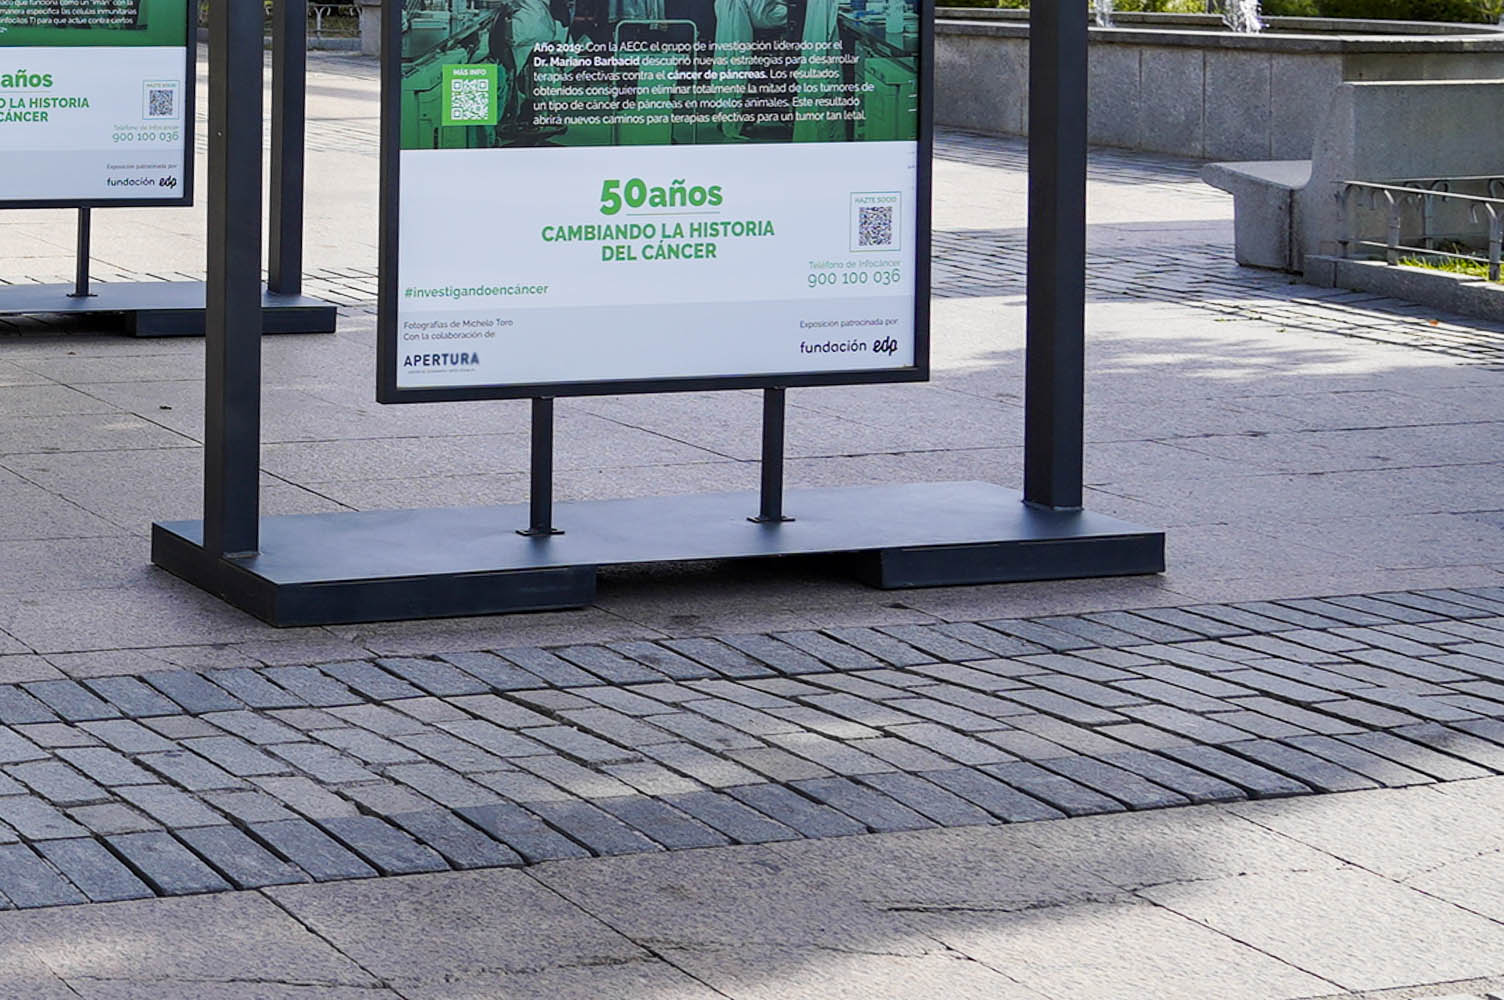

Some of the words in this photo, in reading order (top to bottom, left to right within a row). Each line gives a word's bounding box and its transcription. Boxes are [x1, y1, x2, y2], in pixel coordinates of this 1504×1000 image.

[534, 42, 555, 52] Año
[586, 42, 607, 52] Con
[608, 42, 618, 51] la
[619, 41, 648, 51] AECC
[650, 41, 660, 51] el
[661, 42, 692, 53] grupo
[693, 41, 707, 51] de
[708, 40, 772, 53] investigación
[773, 40, 813, 51] liderado
[815, 42, 832, 52] por
[833, 40, 843, 50] el
[533, 57, 548, 67] Dr.
[549, 57, 593, 66] Mariano
[594, 56, 640, 66] Barbacid
[641, 55, 692, 66] descubrió
[693, 57, 728, 65] nuevas
[730, 55, 783, 67] estrategias
[785, 57, 807, 67] para
[808, 54, 859, 64] desarrollar
[533, 72, 574, 83] terapias
[576, 71, 620, 81] efectivas
[622, 72, 653, 80] contra
[655, 70, 665, 80] el
[667, 70, 703, 80] cáncer
[704, 70, 717, 79] de
[718, 69, 768, 81] páncreas.
[770, 69, 787, 79] Los
[789, 69, 840, 78] resultados
[533, 86, 584, 96] obtenidos
[585, 85, 650, 98] consiguieron
[651, 85, 691, 94] eliminar
[693, 84, 745, 94] totalmente
[747, 83, 758, 93] la
[759, 83, 787, 93] mitad
[788, 83, 802, 92] de
[803, 83, 818, 92] los
[820, 82, 860, 92] tumores
[861, 82, 875, 91] de
[9, 98, 26, 109] LA
[28, 97, 90, 109] HISTORIA
[533, 102, 547, 110] un
[548, 101, 569, 112] tipo
[570, 100, 585, 109] de
[586, 99, 620, 110] cáncer
[622, 99, 636, 109] de
[637, 99, 684, 111] páncreas
[685, 100, 698, 108] en
[699, 98, 743, 108] modelos
[745, 97, 790, 107] animales.
[792, 97, 814, 107] Este
[815, 97, 860, 106] resultado
[533, 114, 562, 125] abrirá
[564, 116, 601, 124] nuevos
[602, 114, 646, 124] caminos
[647, 115, 670, 125] para
[671, 113, 711, 125] terapias
[712, 112, 756, 122] efectivas
[757, 112, 779, 123] para
[780, 113, 794, 121] un
[795, 111, 825, 120] tumor
[826, 111, 843, 120] tan
[112, 132, 134, 143] 900
[136, 132, 156, 141] 100
[159, 131, 180, 143] 036
[107, 176, 156, 187] fundación
[599, 178, 724, 216] 50años
[541, 223, 657, 242] CAMBIANDO
[660, 223, 685, 240] LA
[689, 220, 776, 239] HISTORIA
[601, 245, 638, 262] DEL
[641, 240, 717, 260] CÁNCER
[807, 273, 837, 288] 900
[842, 271, 869, 285] 100
[873, 268, 901, 286] 036
[404, 284, 549, 300] #investigandoencáncer
[449, 319, 461, 329] de
[496, 318, 514, 327] Toro
[799, 319, 839, 329] Exposición
[841, 318, 884, 328] patrocinada
[403, 333, 420, 341] Con
[421, 332, 430, 340] la
[431, 330, 482, 340] colaboración
[799, 339, 867, 353] fundación
[872, 335, 898, 357] edp
[402, 352, 480, 368] APERTURA
